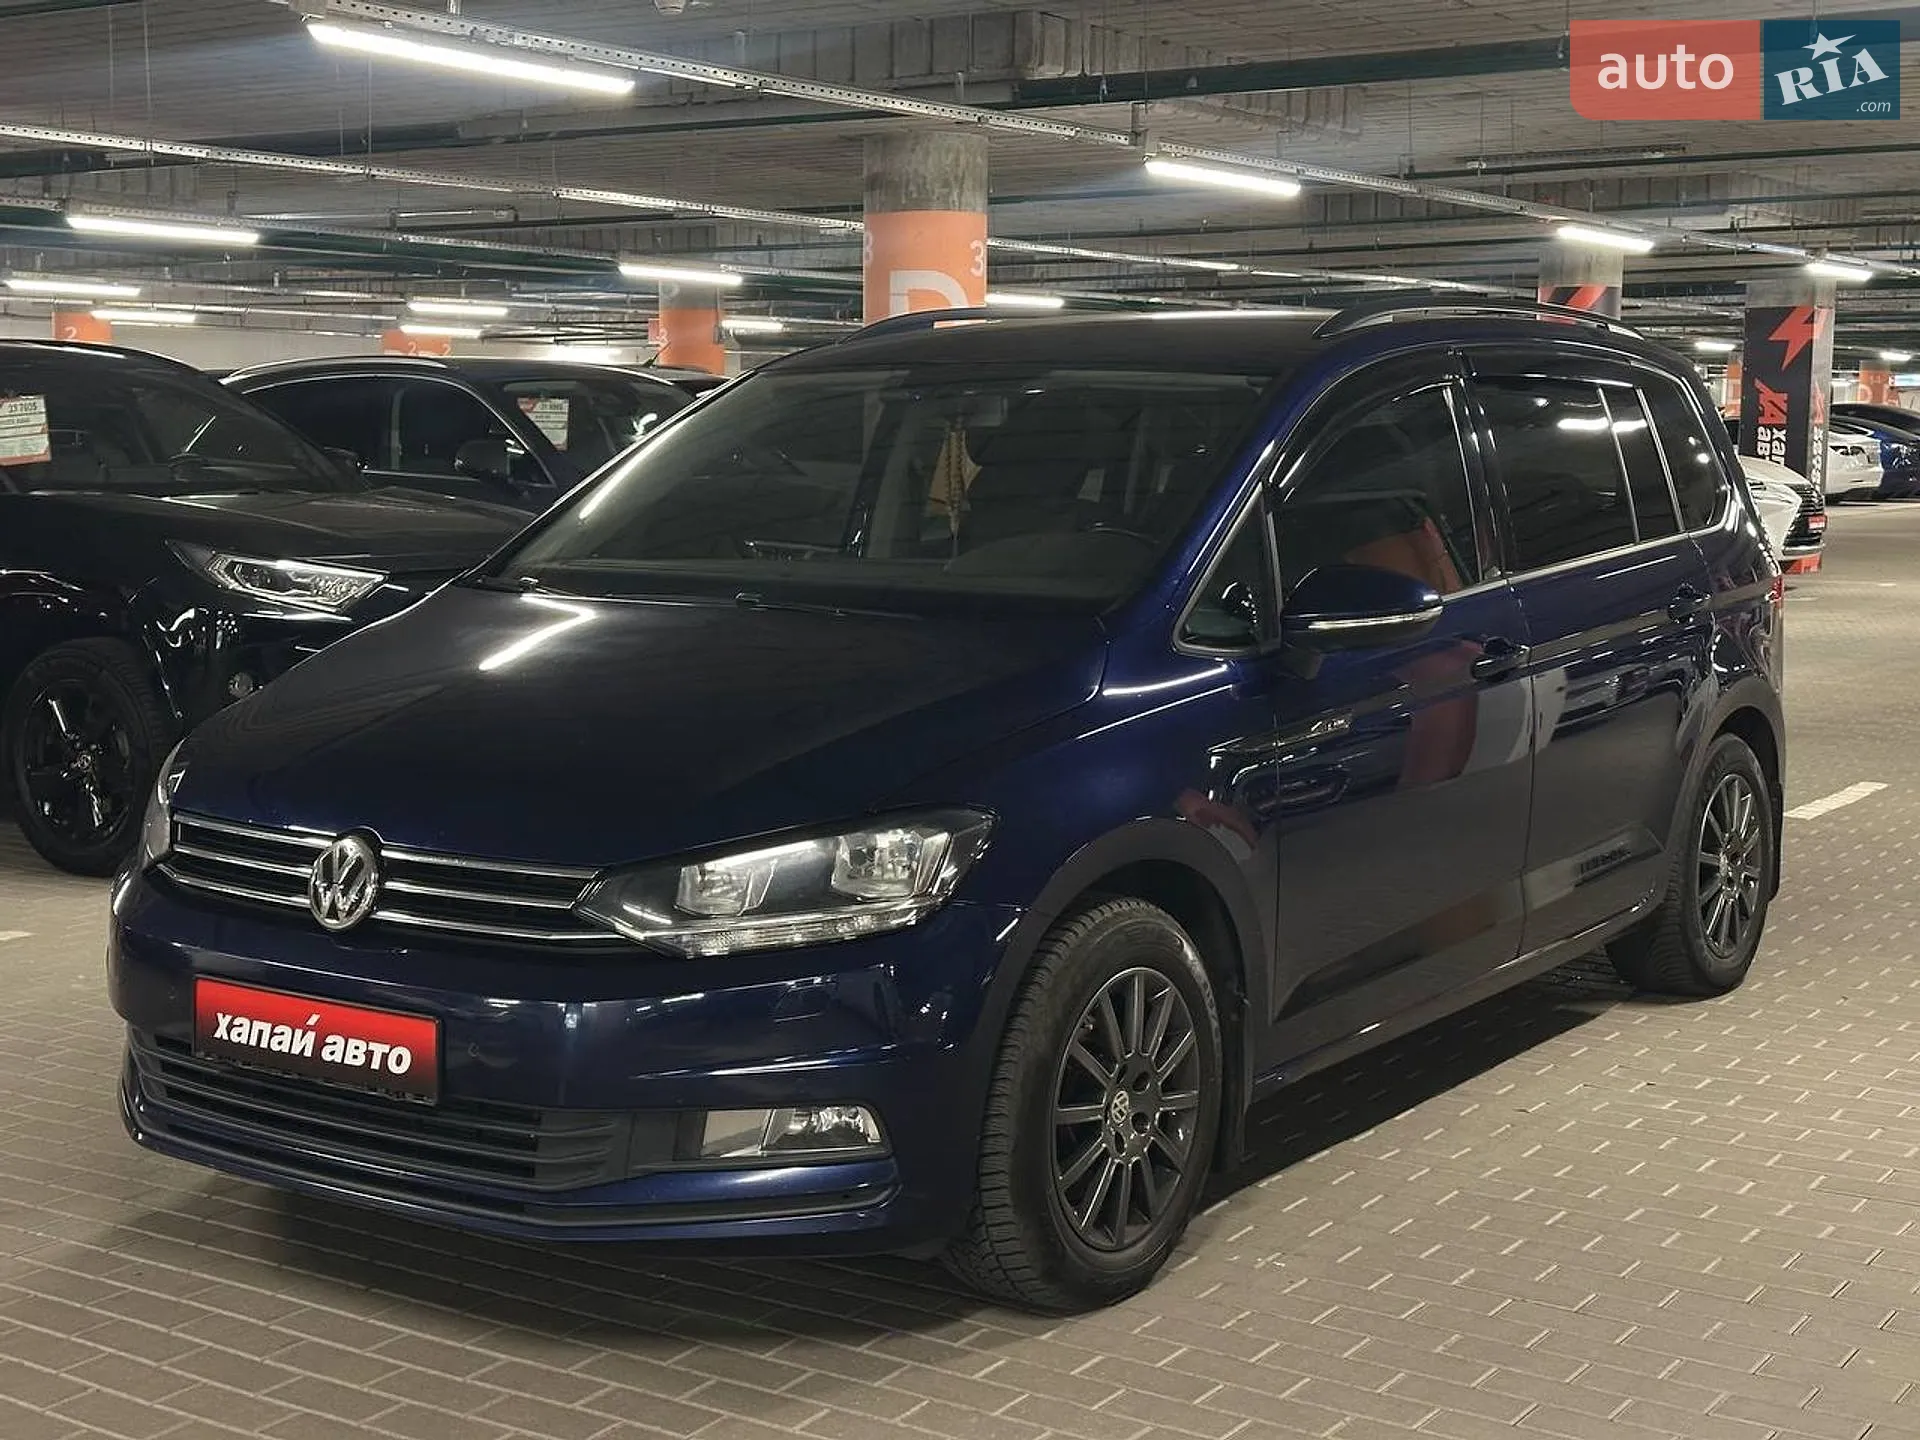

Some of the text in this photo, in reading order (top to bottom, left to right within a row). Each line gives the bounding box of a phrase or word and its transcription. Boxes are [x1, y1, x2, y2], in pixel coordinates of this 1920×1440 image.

[970, 240, 985, 277] 3
[407, 341, 417, 357] 2
[321, 1033, 412, 1075] авто
